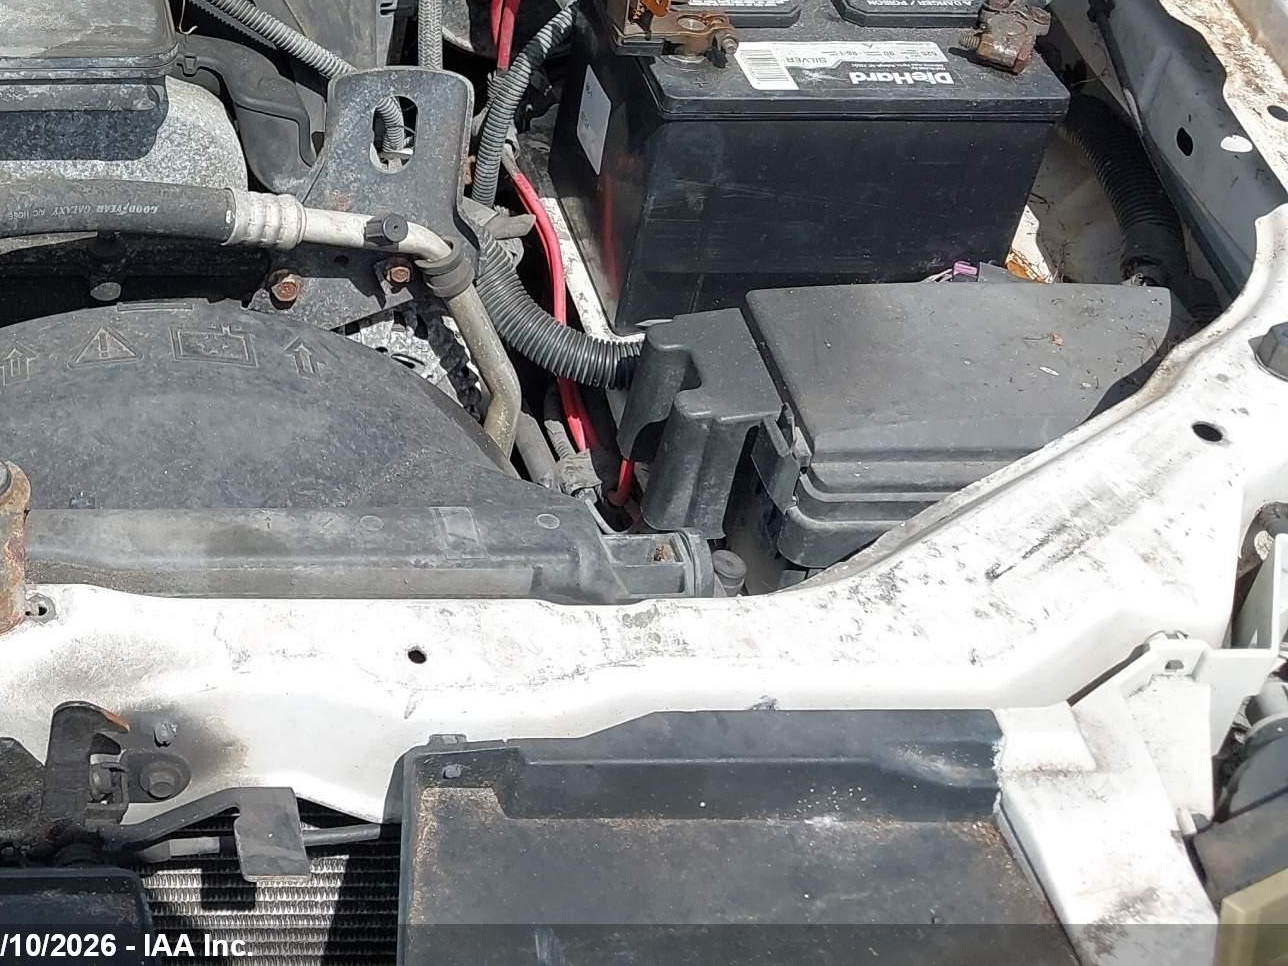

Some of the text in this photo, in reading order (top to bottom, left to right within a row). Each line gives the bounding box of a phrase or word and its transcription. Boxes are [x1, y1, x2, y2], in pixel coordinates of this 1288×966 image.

[785, 57, 827, 65] SILVER
[848, 71, 955, 85] DieHard
[52, 204, 92, 216] GALAXY
[96, 202, 160, 215] GOODYEAR
